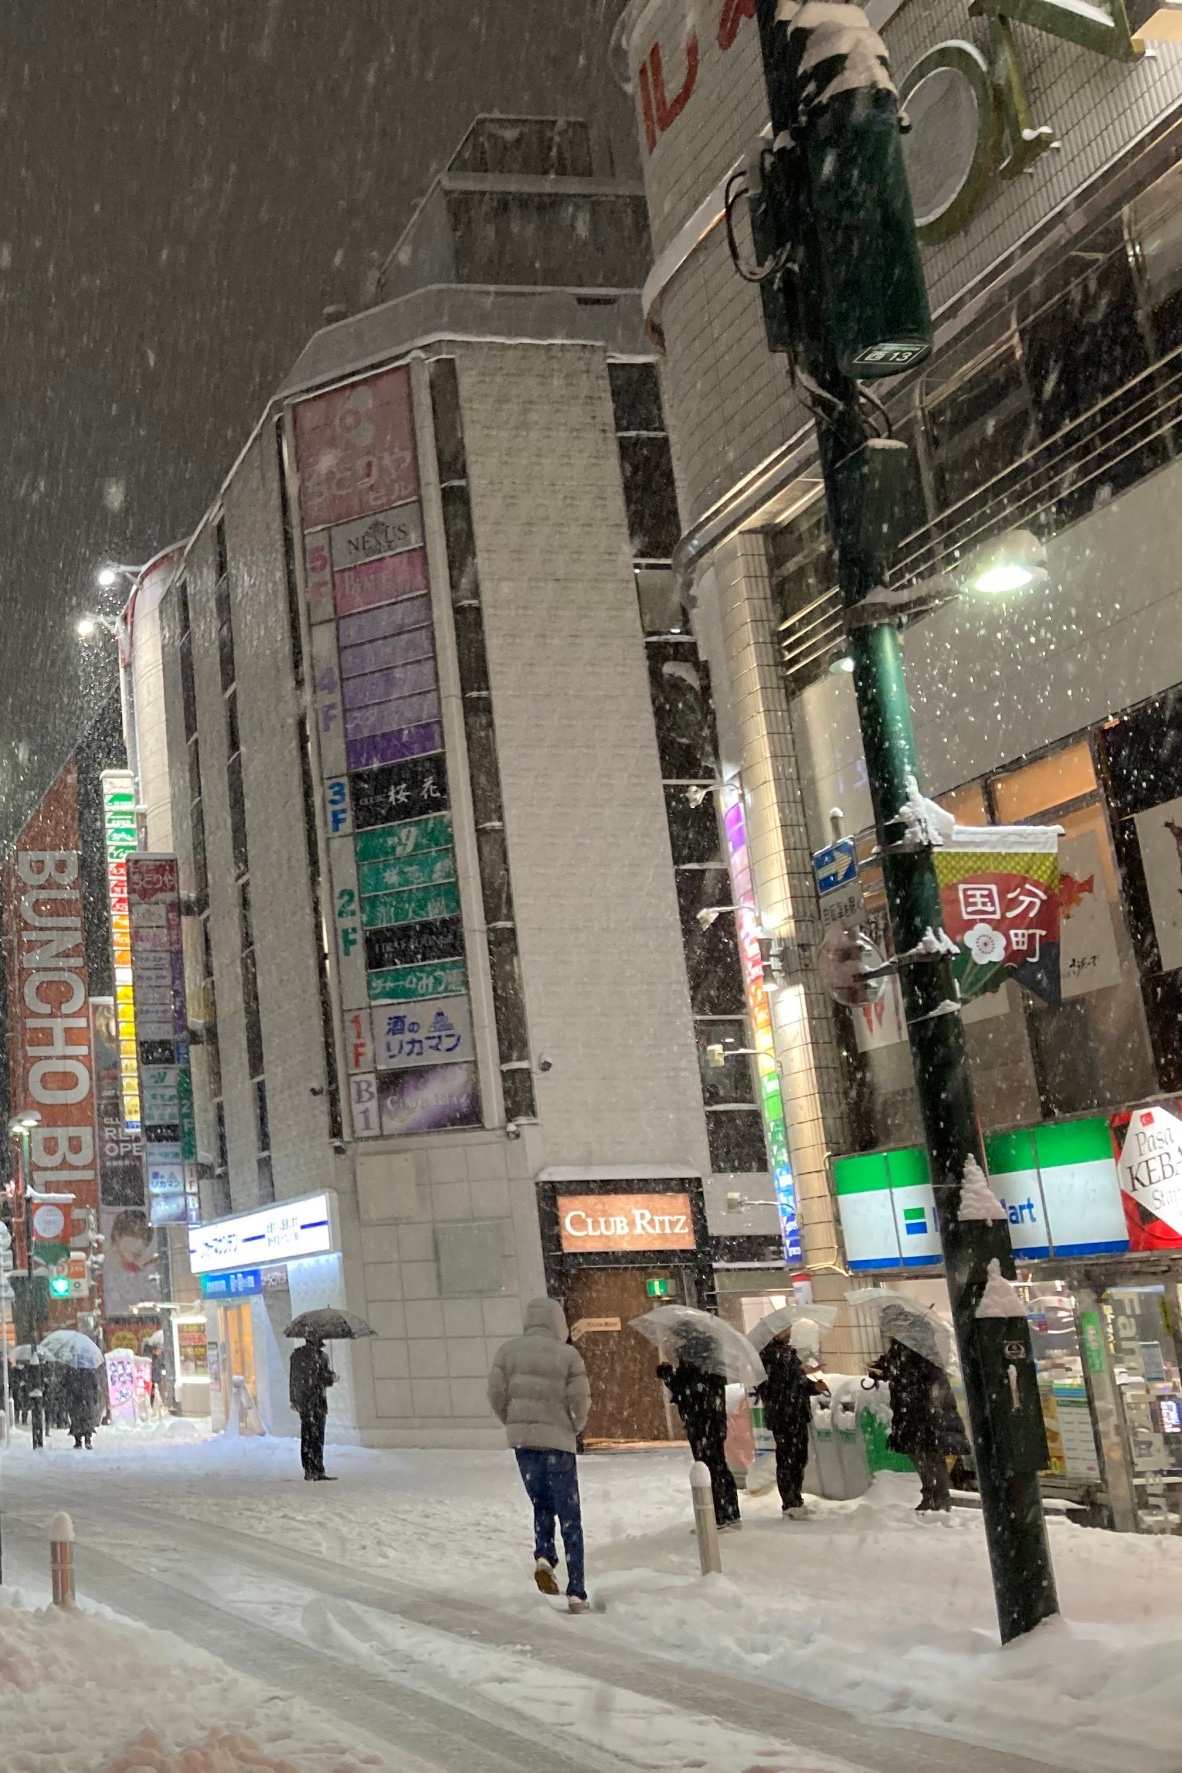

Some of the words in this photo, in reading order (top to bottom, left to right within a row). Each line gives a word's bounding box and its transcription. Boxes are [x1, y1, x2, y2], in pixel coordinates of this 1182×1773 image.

[347, 523, 409, 555] NEXUS
[328, 781, 349, 833] 3F
[337, 888, 359, 957] 2F
[17, 850, 91, 1104] BUNCHO
[349, 1014, 368, 1069] 1F
[386, 1015, 421, 1036] 酒の
[386, 1032, 462, 1060] リカマン
[353, 1081, 376, 1133] B1
